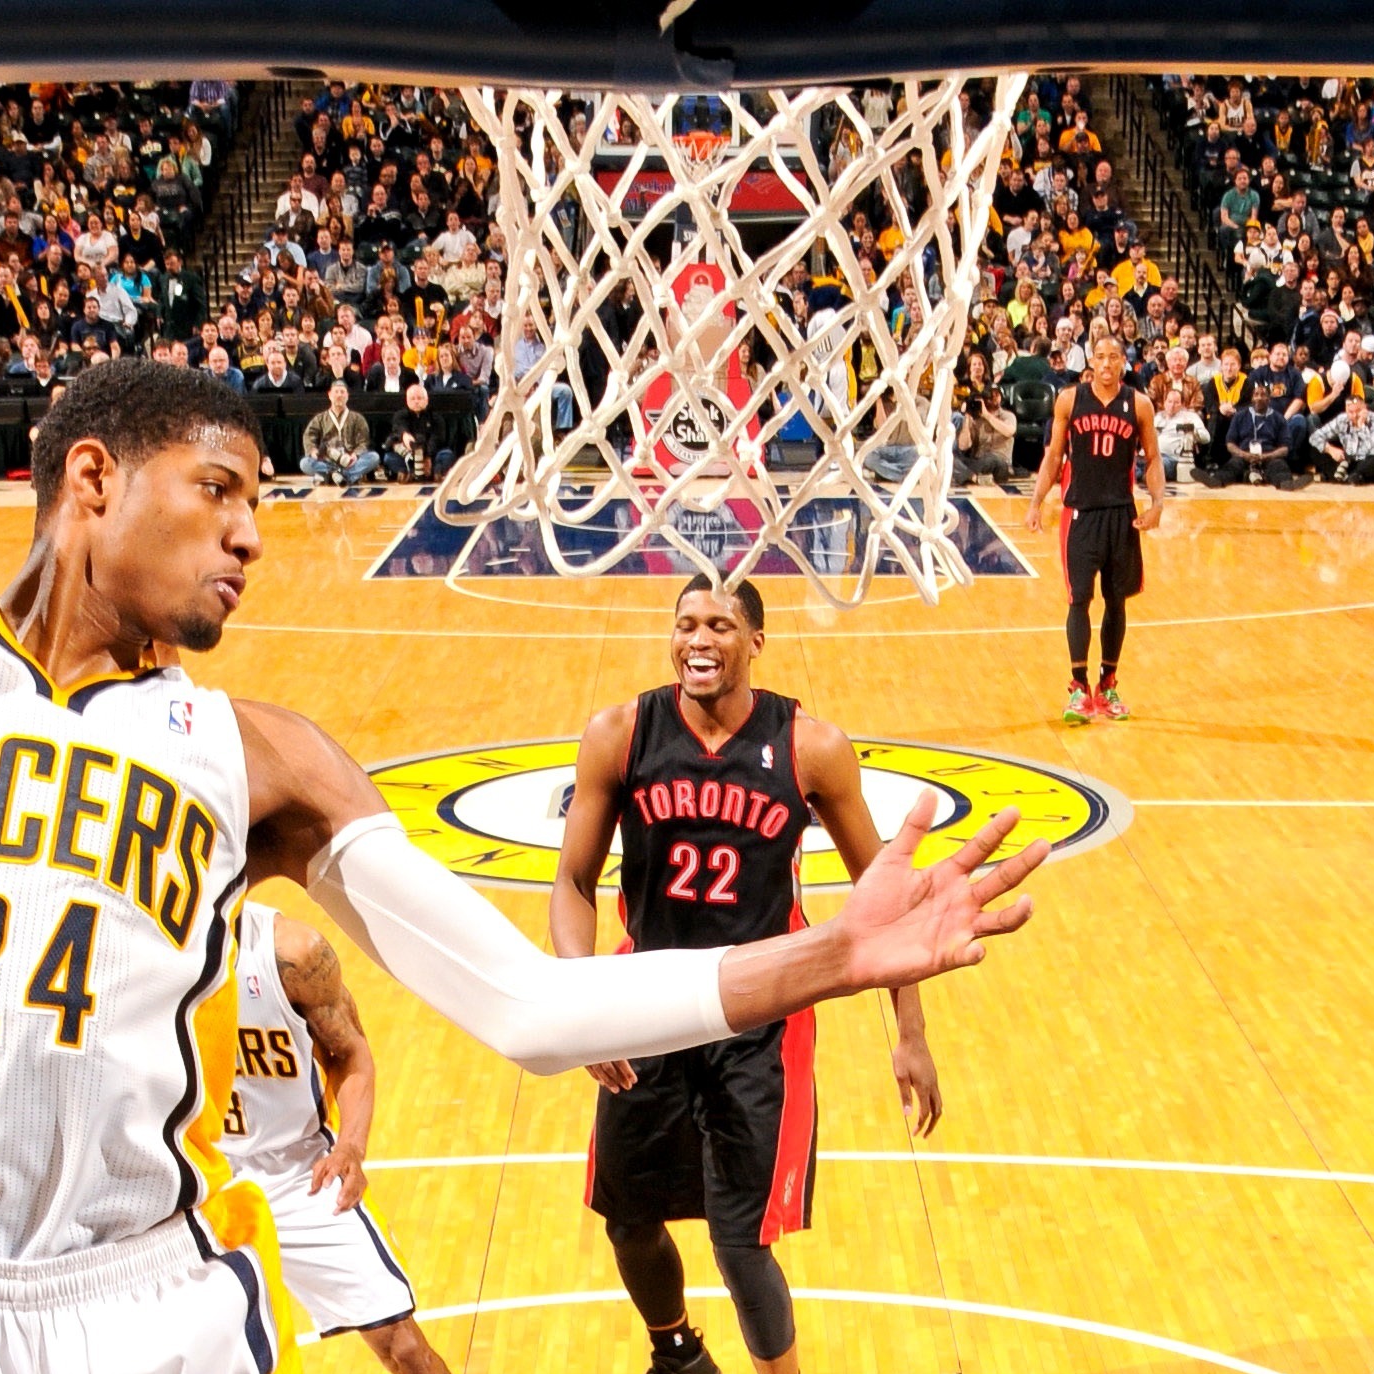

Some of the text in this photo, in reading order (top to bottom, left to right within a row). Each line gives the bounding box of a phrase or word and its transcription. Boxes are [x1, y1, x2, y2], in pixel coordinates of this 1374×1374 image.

[1073, 413, 1134, 440] TORONTO
[1092, 431, 1115, 457] 10
[634, 779, 790, 839] TORONTO
[666, 841, 741, 903] 22
[236, 1026, 300, 1079] RS
